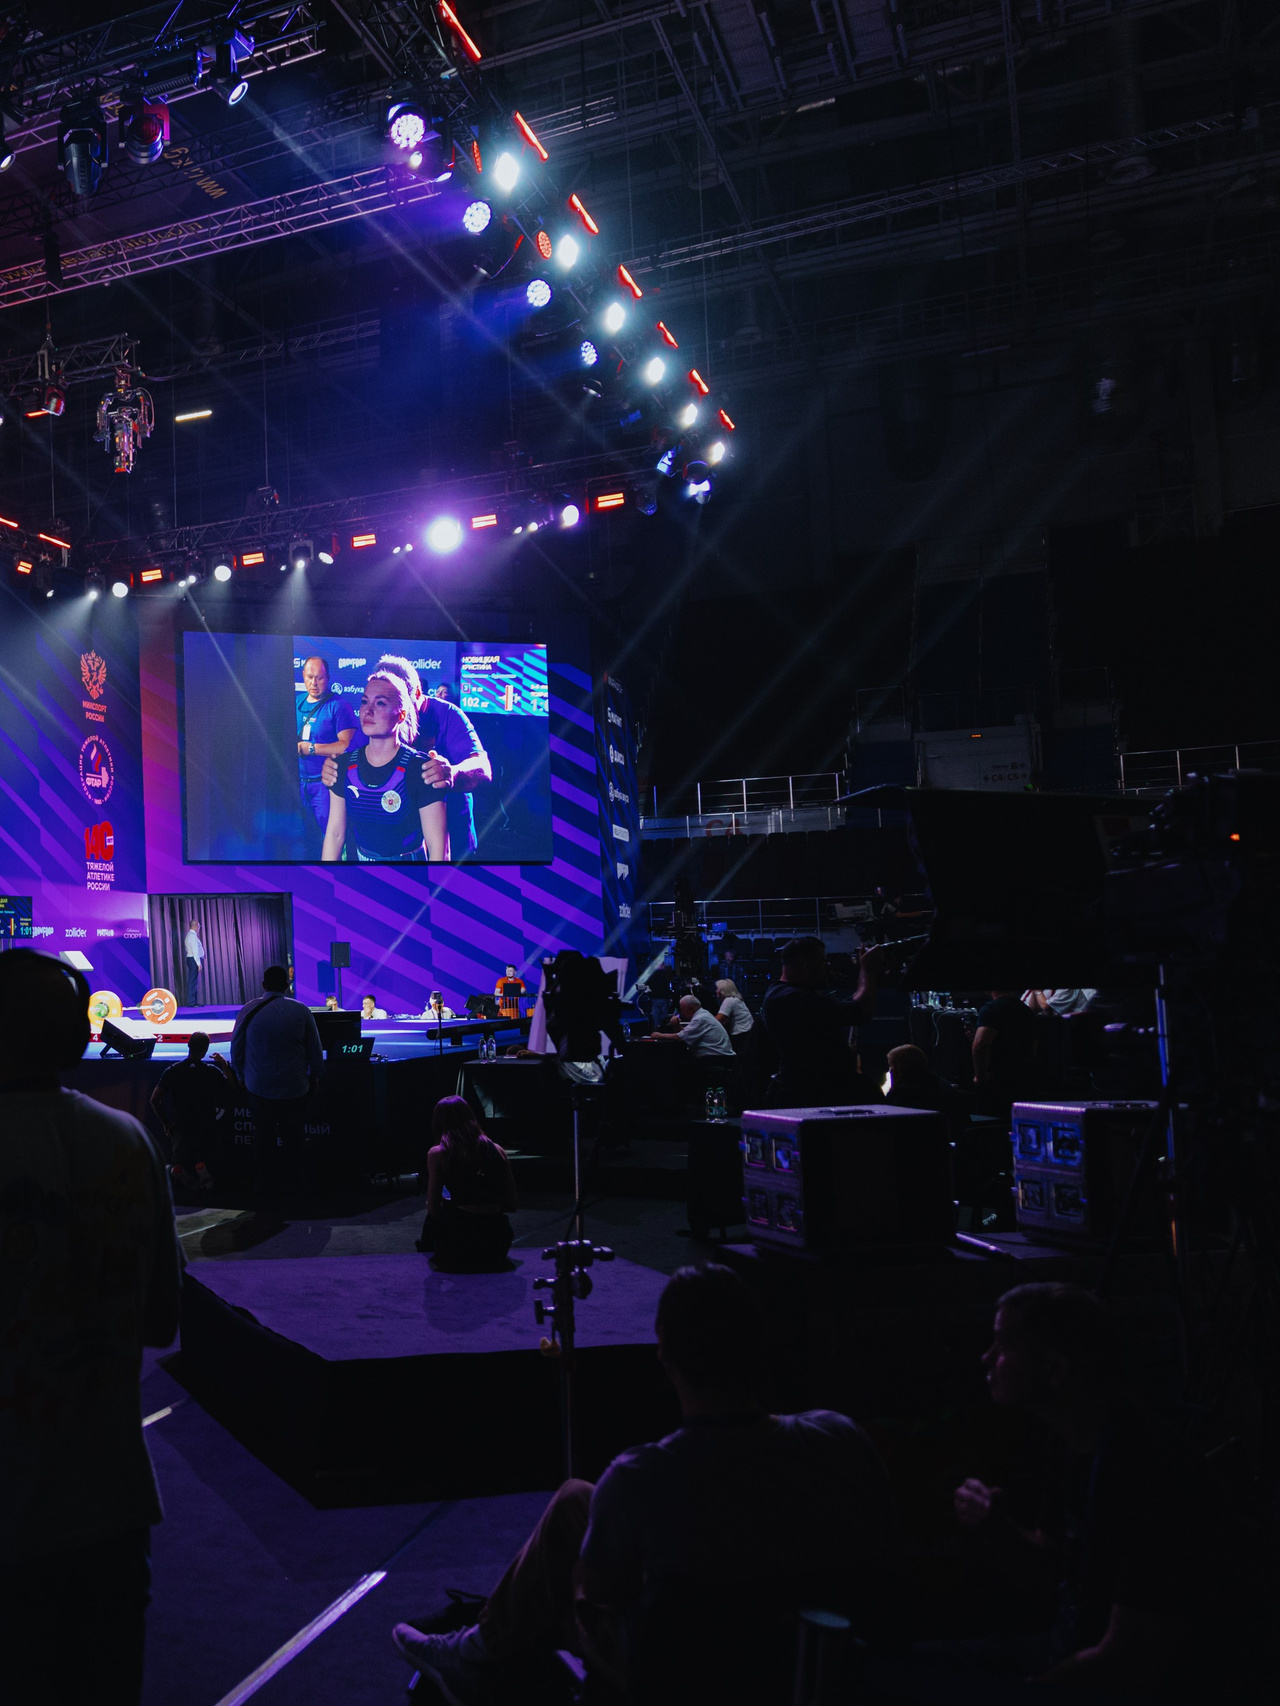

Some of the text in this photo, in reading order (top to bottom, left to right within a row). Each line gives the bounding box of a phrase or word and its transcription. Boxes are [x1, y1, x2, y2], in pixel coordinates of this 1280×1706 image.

[462, 697, 479, 707] 102
[86, 861, 114, 872] ТЯЖЕЛОЙ
[86, 871, 115, 881] АТЛЕТИКЕ
[86, 881, 111, 891] РОССИИ
[20, 926, 32, 935] 1:01
[65, 927, 87, 937] zollider
[157, 1034, 163, 1042] 2
[342, 1044, 363, 1053] 1:01
